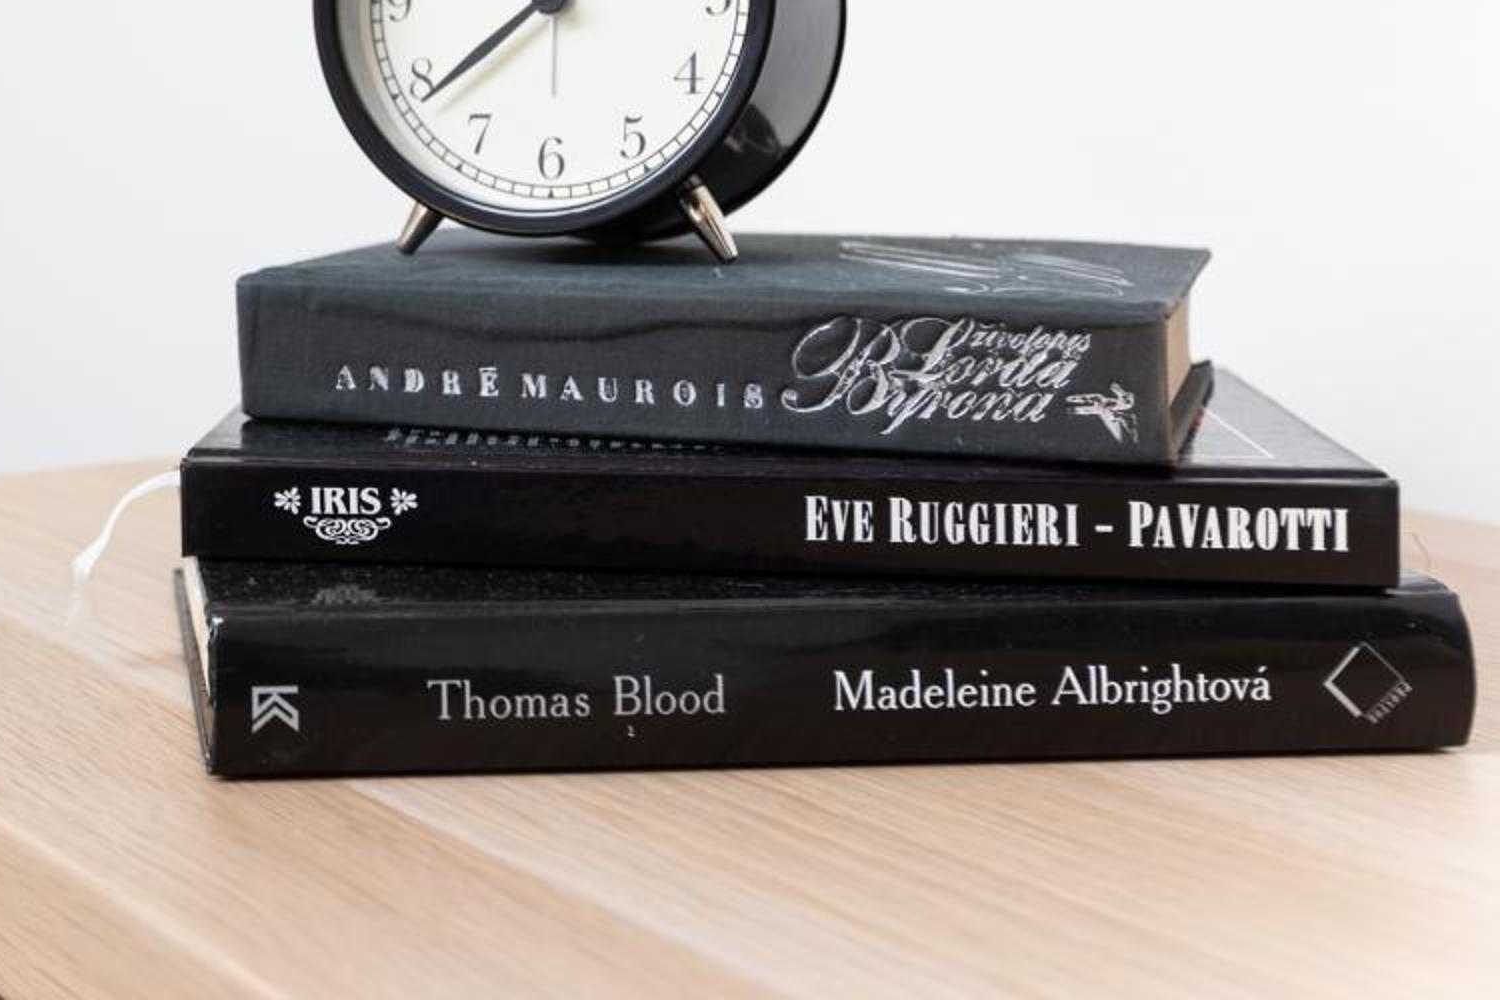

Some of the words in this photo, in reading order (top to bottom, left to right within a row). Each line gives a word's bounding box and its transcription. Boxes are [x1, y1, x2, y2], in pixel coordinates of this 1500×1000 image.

[410, 56, 436, 100] 8
[672, 50, 705, 96] 4
[467, 112, 493, 156] 7
[619, 114, 648, 160] 5
[536, 136, 566, 181] 6
[780, 316, 1056, 436] Byrona
[892, 316, 1082, 390] Lorda
[519, 372, 764, 410] MAUROIS
[309, 486, 382, 516] IRIS
[803, 494, 875, 544] EVE
[887, 495, 1080, 548] RUGGIERI
[1127, 499, 1350, 554] PAVAROTTI
[426, 678, 592, 721] Thomas
[612, 672, 726, 717] Blood
[832, 666, 1038, 712] Madeleine
[1050, 661, 1273, 716] Albrightová
